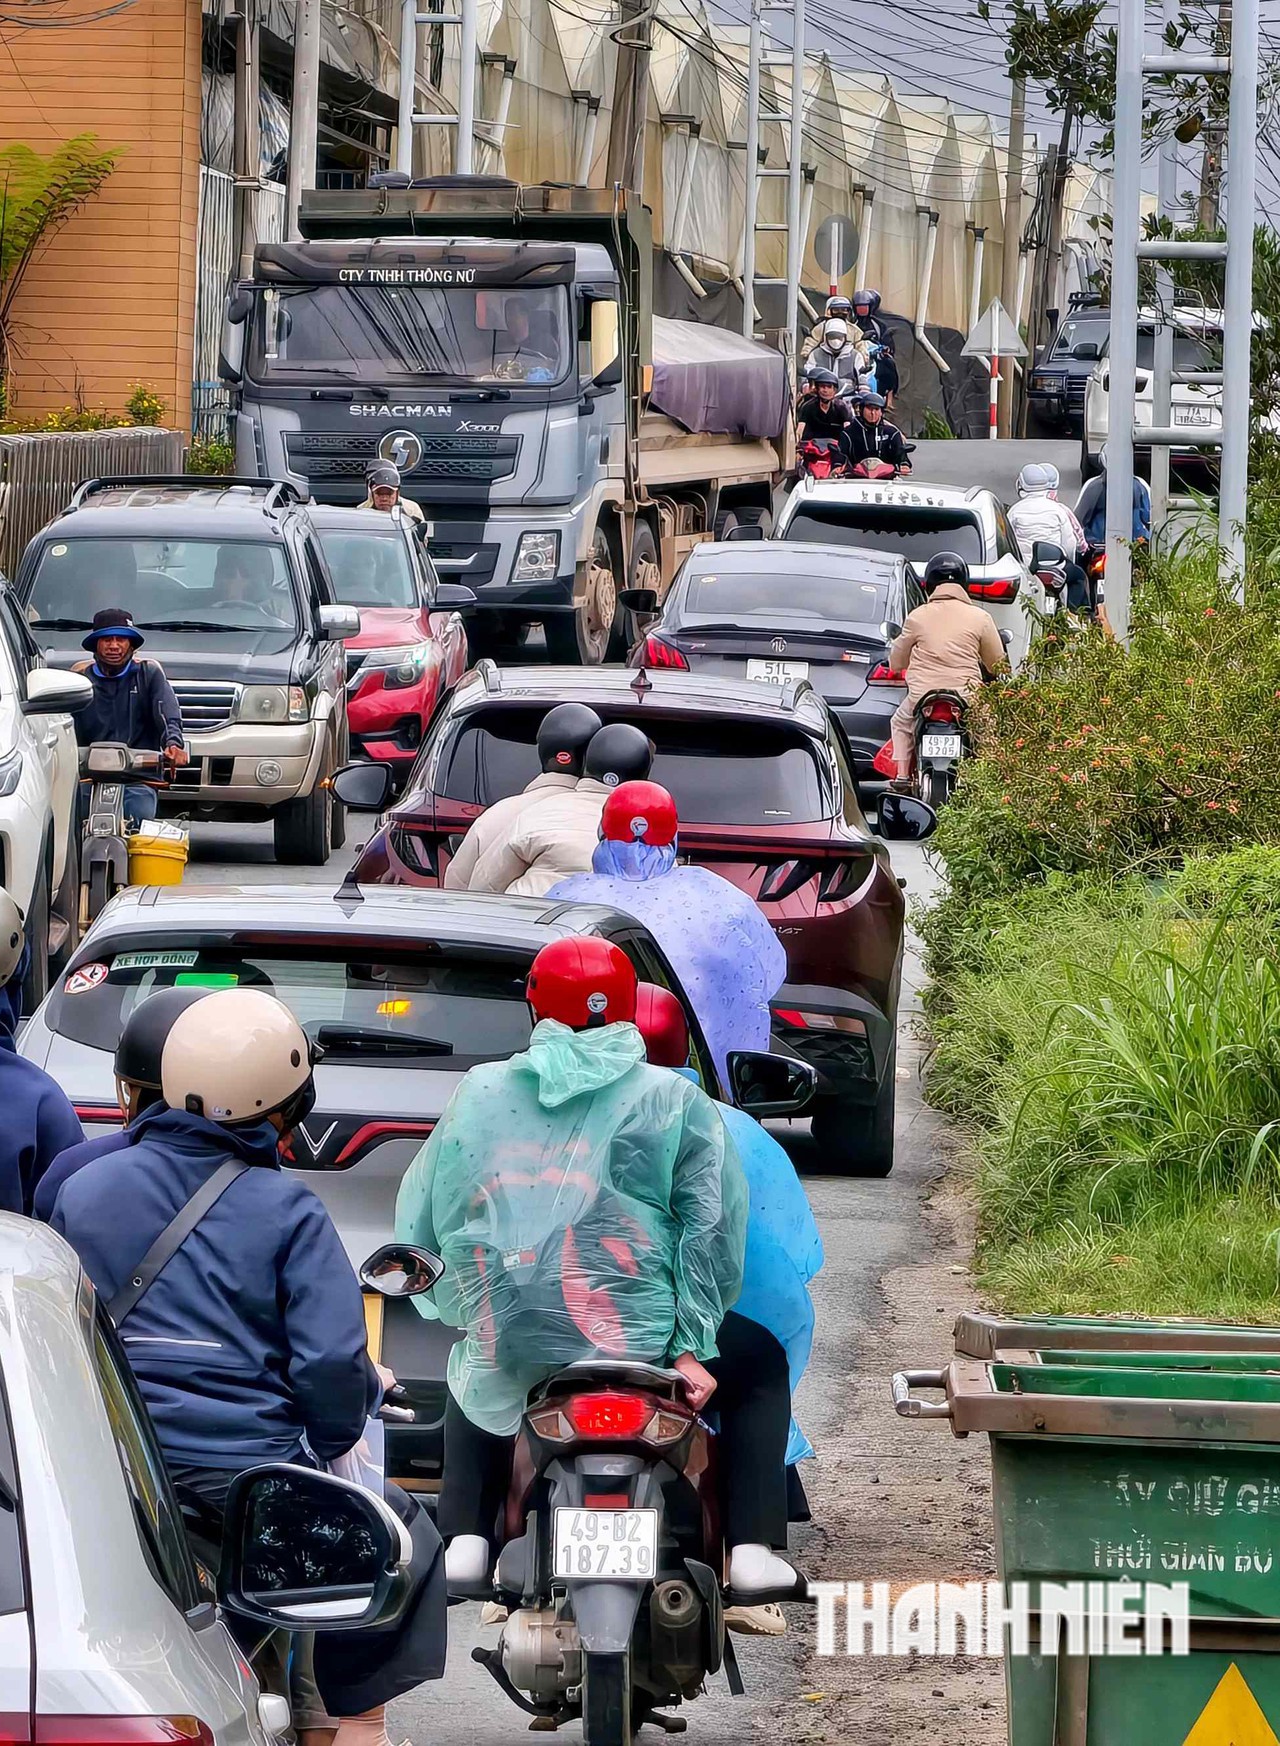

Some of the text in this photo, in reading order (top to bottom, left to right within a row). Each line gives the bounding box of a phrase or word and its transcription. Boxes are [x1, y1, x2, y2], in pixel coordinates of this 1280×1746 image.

[339, 269, 364, 281] CTY
[368, 269, 404, 282] TNHH
[407, 267, 453, 282] THÔNG
[349, 404, 452, 417] SHACMAN
[765, 662, 791, 675] 51L
[570, 1512, 642, 1542] 49-B2
[562, 1545, 651, 1574] 187.39
